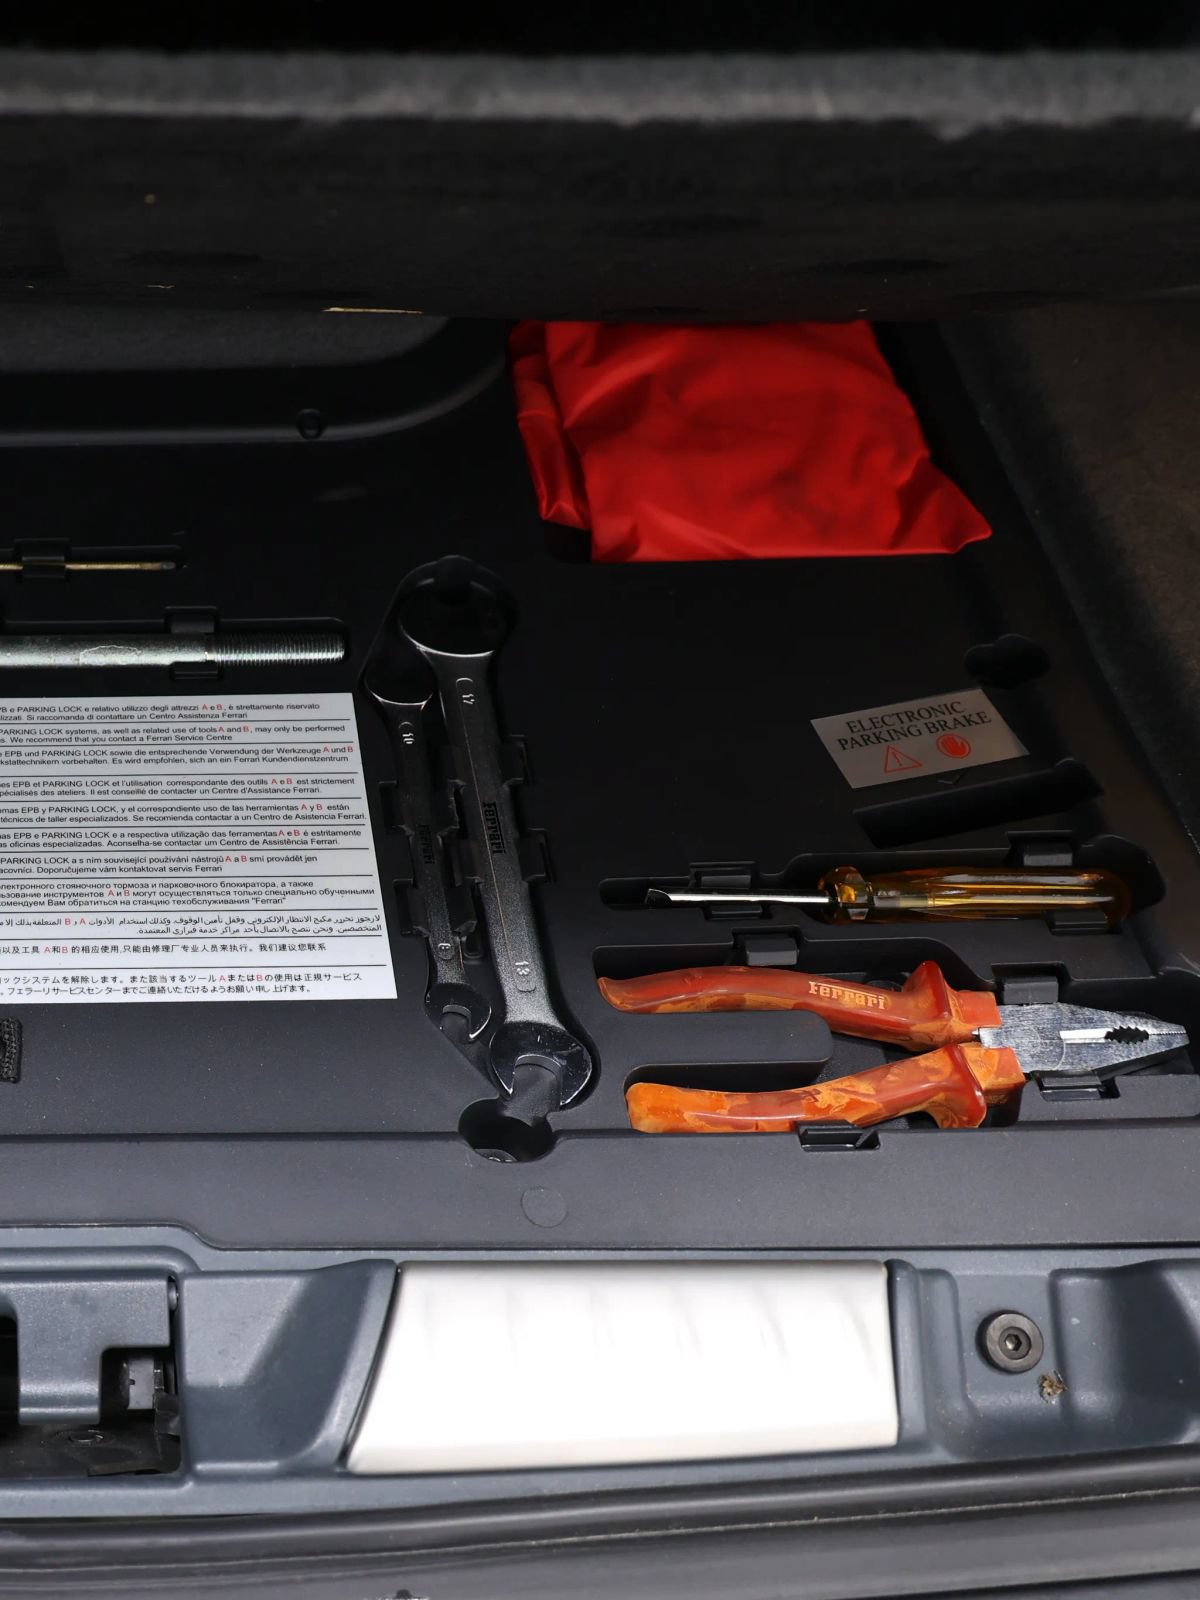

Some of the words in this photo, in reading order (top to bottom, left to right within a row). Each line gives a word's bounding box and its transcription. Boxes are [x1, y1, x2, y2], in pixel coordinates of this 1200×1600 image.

[846, 701, 967, 734] ELECTRONIC
[838, 724, 922, 750] PARKING
[925, 712, 992, 734] BRAKE
[261, 754, 348, 762] Kundendienstzentrum
[136, 805, 201, 813] correspondiente
[293, 811, 336, 820] Asistencia
[482, 802, 506, 854] Ferrari
[163, 838, 202, 846] contactar
[251, 896, 286, 904] "Ferrari"
[808, 981, 886, 1010] Ferrari
